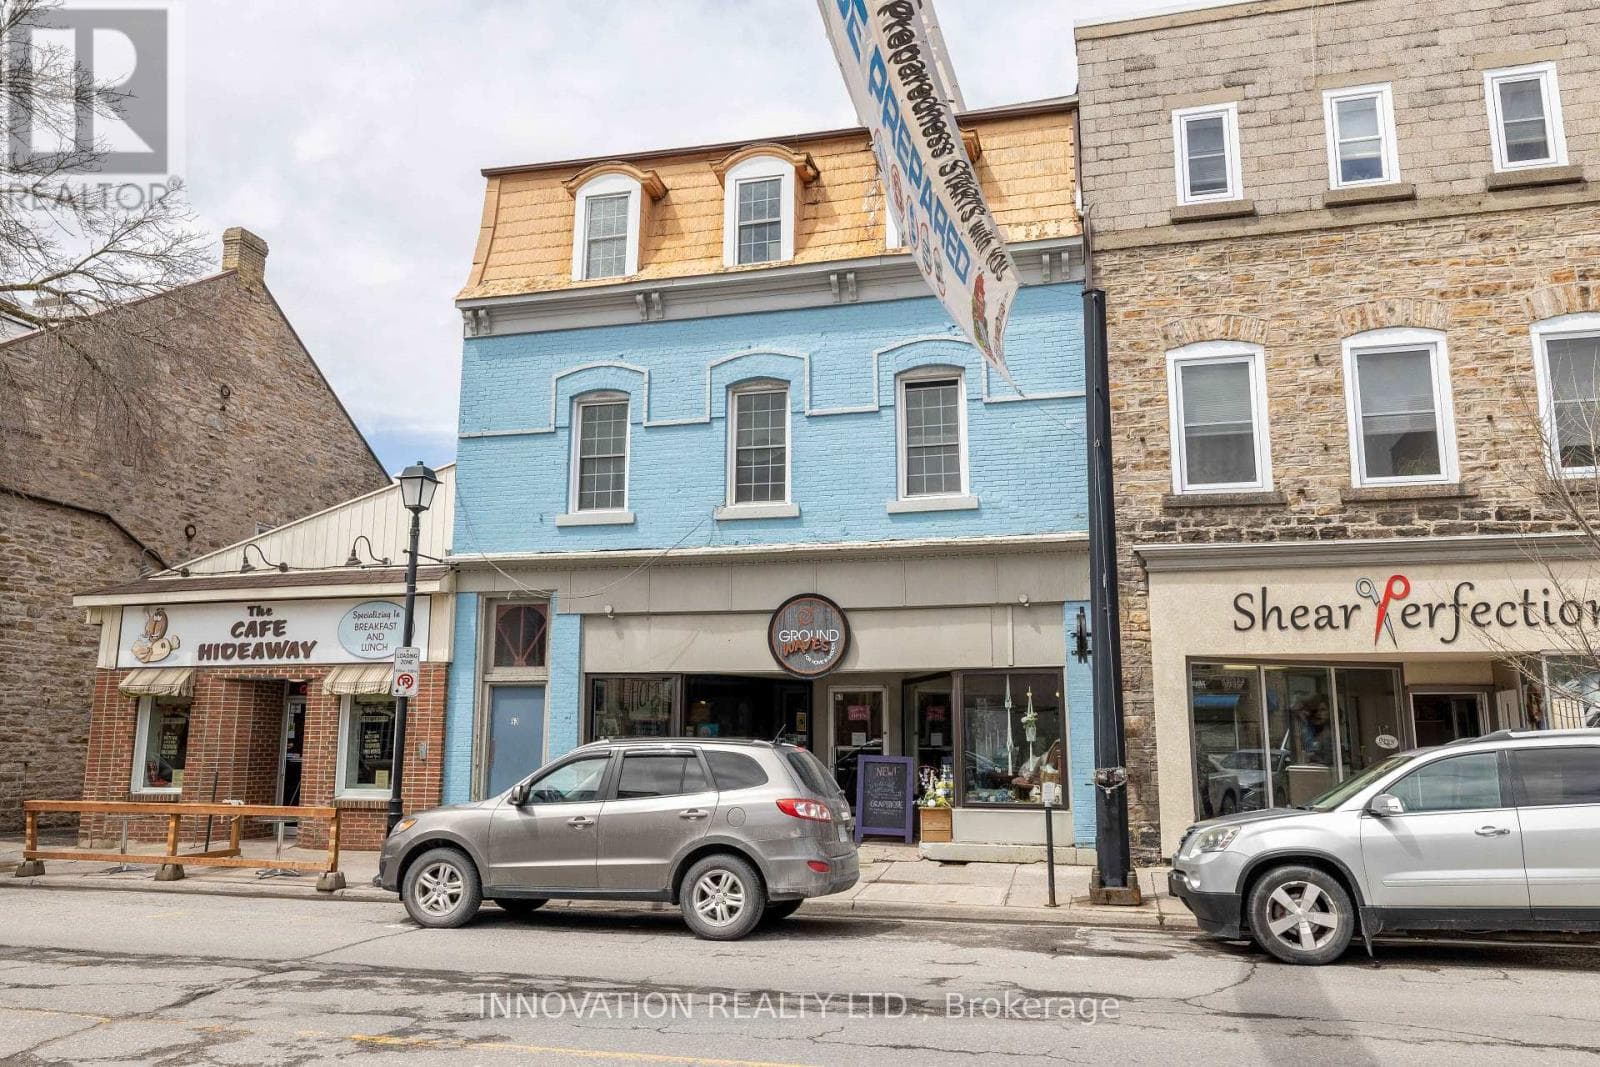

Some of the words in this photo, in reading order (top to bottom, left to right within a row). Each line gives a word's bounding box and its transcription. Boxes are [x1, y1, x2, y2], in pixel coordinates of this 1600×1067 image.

[868, 44, 971, 285] PREPARED
[939, 160, 986, 222] STARTS
[968, 220, 995, 255] with
[247, 605, 273, 617] The
[352, 610, 391, 620] Specializing
[1233, 586, 1361, 632] Shear
[230, 619, 288, 638] CAFE
[354, 622, 398, 631] BREAKFAST
[366, 632, 385, 641] AND
[778, 629, 840, 642] GROUND
[197, 640, 318, 661] HIDEAWAY
[361, 643, 389, 652] LUNCH
[783, 636, 830, 658] WAVES
